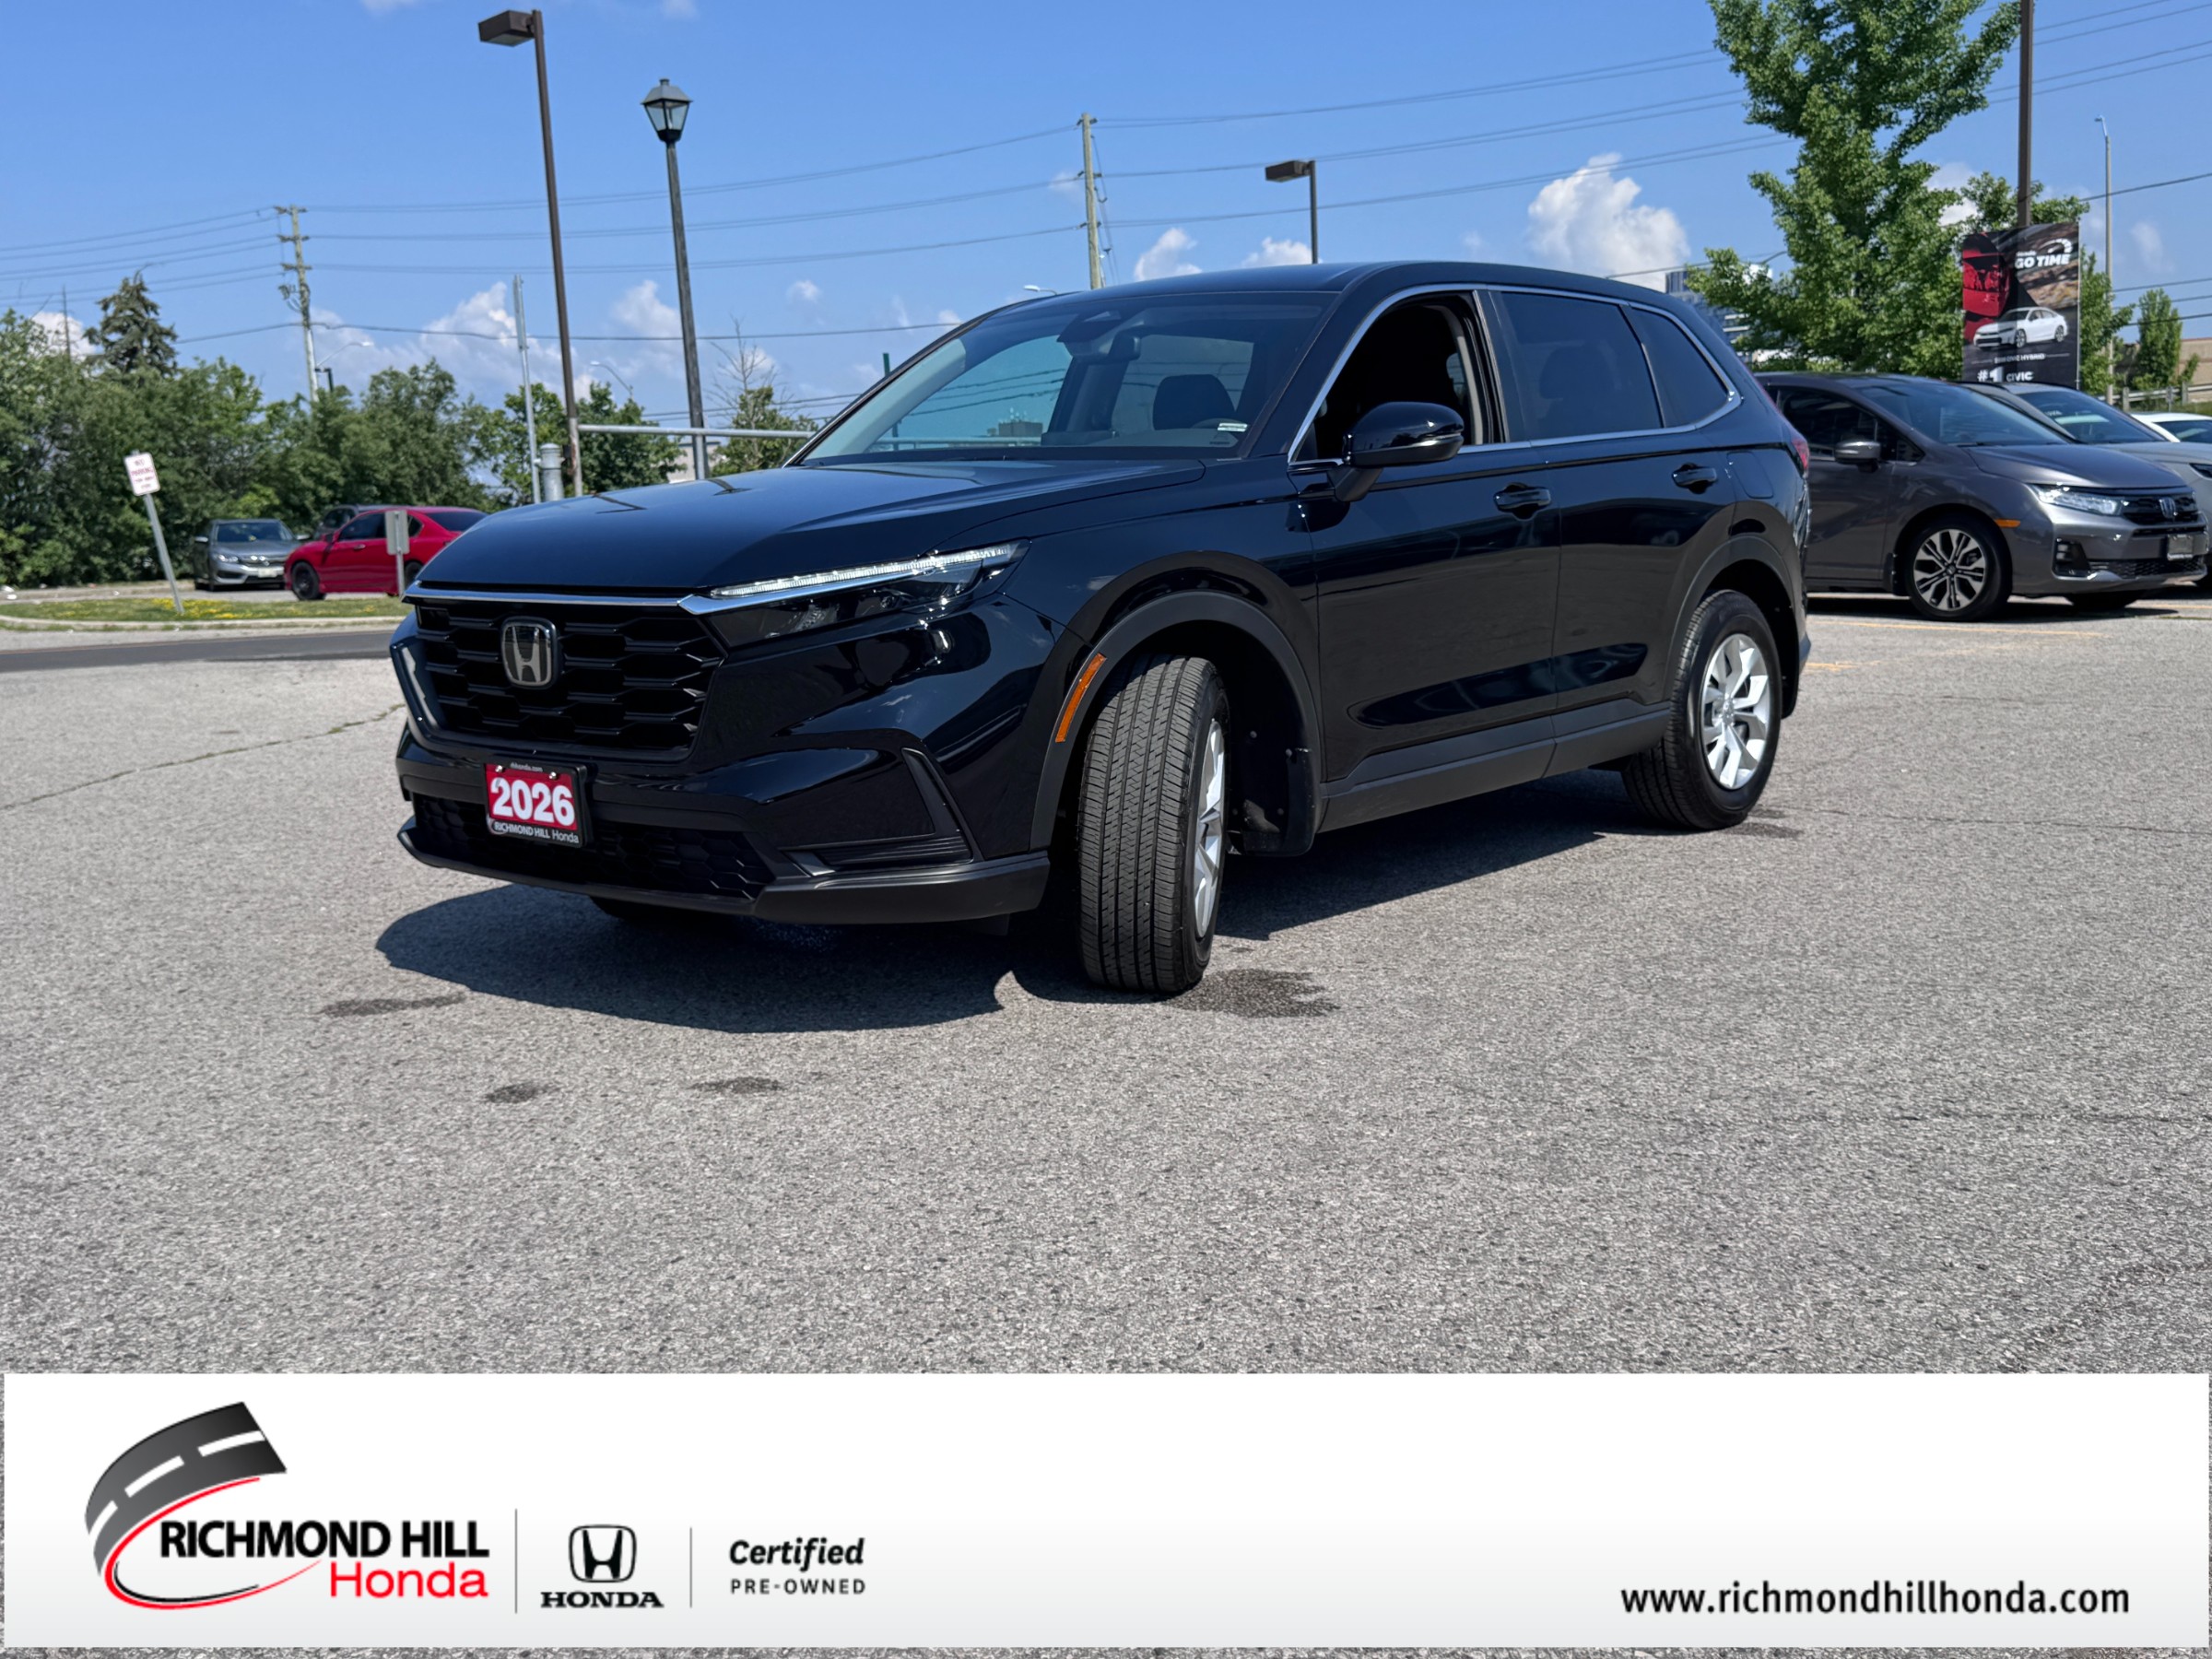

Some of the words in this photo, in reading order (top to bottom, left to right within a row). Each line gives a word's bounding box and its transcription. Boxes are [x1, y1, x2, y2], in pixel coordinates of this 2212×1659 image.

[2015, 256, 2035, 269] GO
[2037, 253, 2071, 267] TIME
[2006, 371, 2034, 382] CIVIC
[490, 777, 576, 827] 2026
[494, 821, 534, 836] RICHMOND
[534, 827, 550, 839] HILL
[552, 829, 580, 843] Honda
